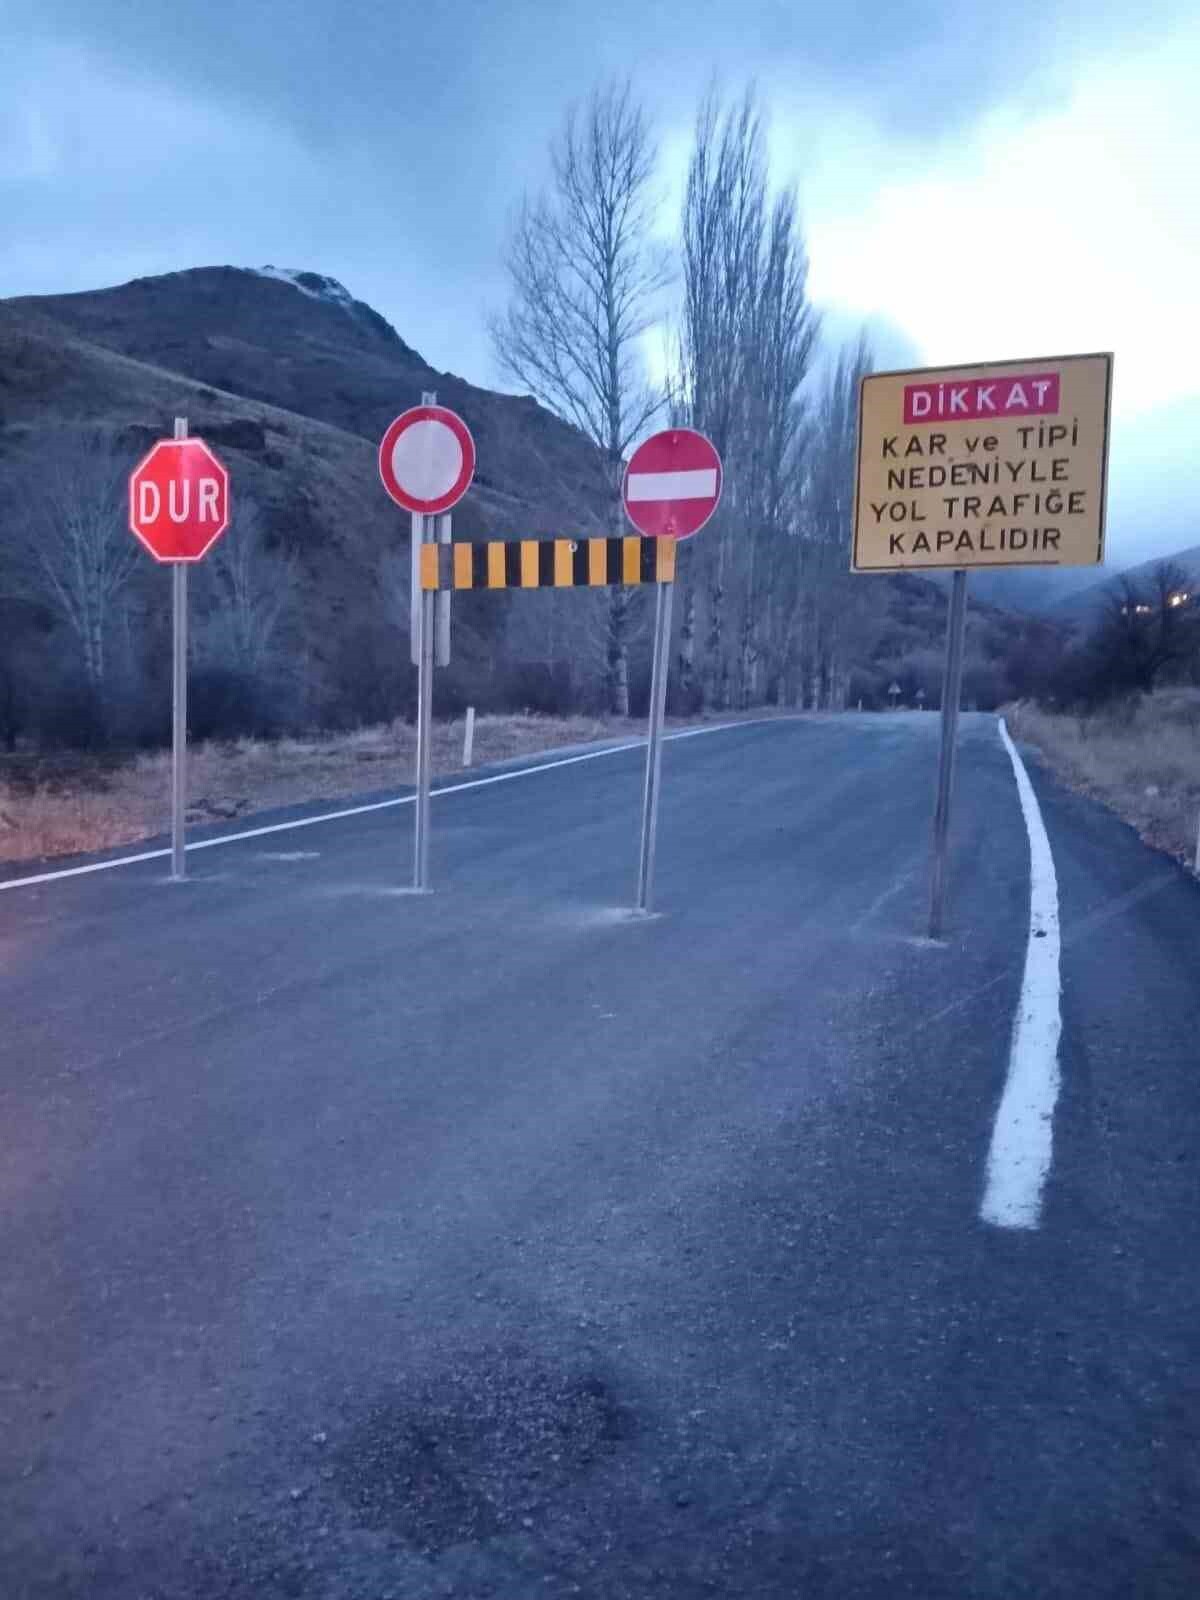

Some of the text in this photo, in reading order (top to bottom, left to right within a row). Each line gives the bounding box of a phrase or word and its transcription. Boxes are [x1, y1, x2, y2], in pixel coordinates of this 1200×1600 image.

[911, 380, 1052, 416] DİKKAT
[882, 417, 1079, 459] KAR ve TİPİ
[887, 456, 1070, 491] NEDENİYLE
[139, 477, 220, 525] DUR
[870, 500, 926, 523] YOL
[889, 527, 1061, 554] KAPALIDIR
